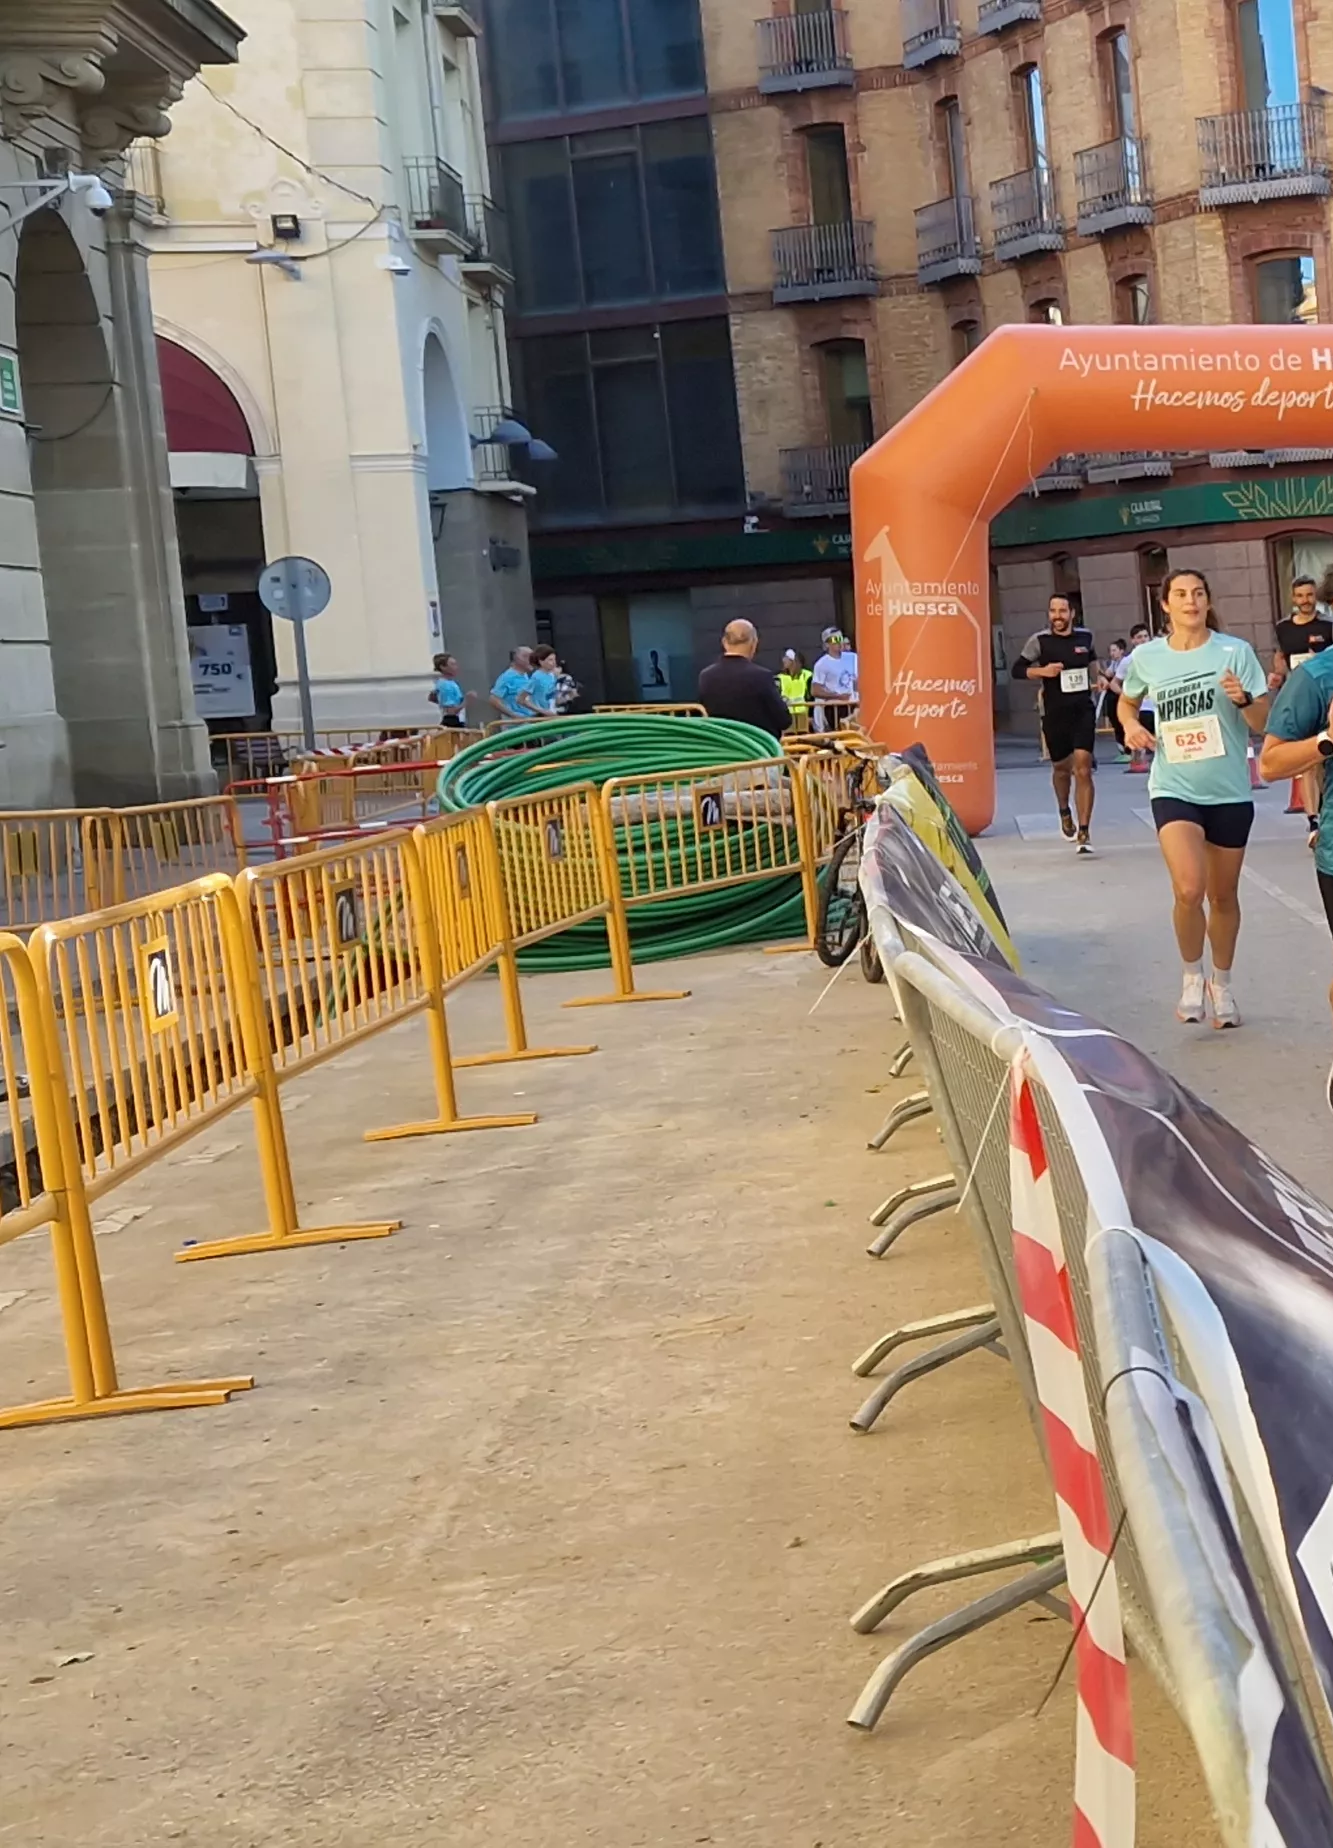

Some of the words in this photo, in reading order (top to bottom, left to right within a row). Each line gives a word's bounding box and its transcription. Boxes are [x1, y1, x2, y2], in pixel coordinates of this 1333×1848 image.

[1059, 348, 1260, 377] Ayuntamiento
[1269, 349, 1302, 371] de
[1130, 379, 1247, 412] Hacemos
[866, 579, 979, 599] Ayuntamiento
[867, 599, 883, 615] de
[888, 600, 959, 616] Huesca
[199, 663, 232, 676] 750
[891, 669, 977, 697] Hacemos
[1168, 682, 1201, 698] CARRERA
[893, 693, 968, 728] deporte
[1157, 688, 1215, 722] MPRESAS
[1175, 731, 1207, 747] 626
[935, 773, 964, 783] esca
